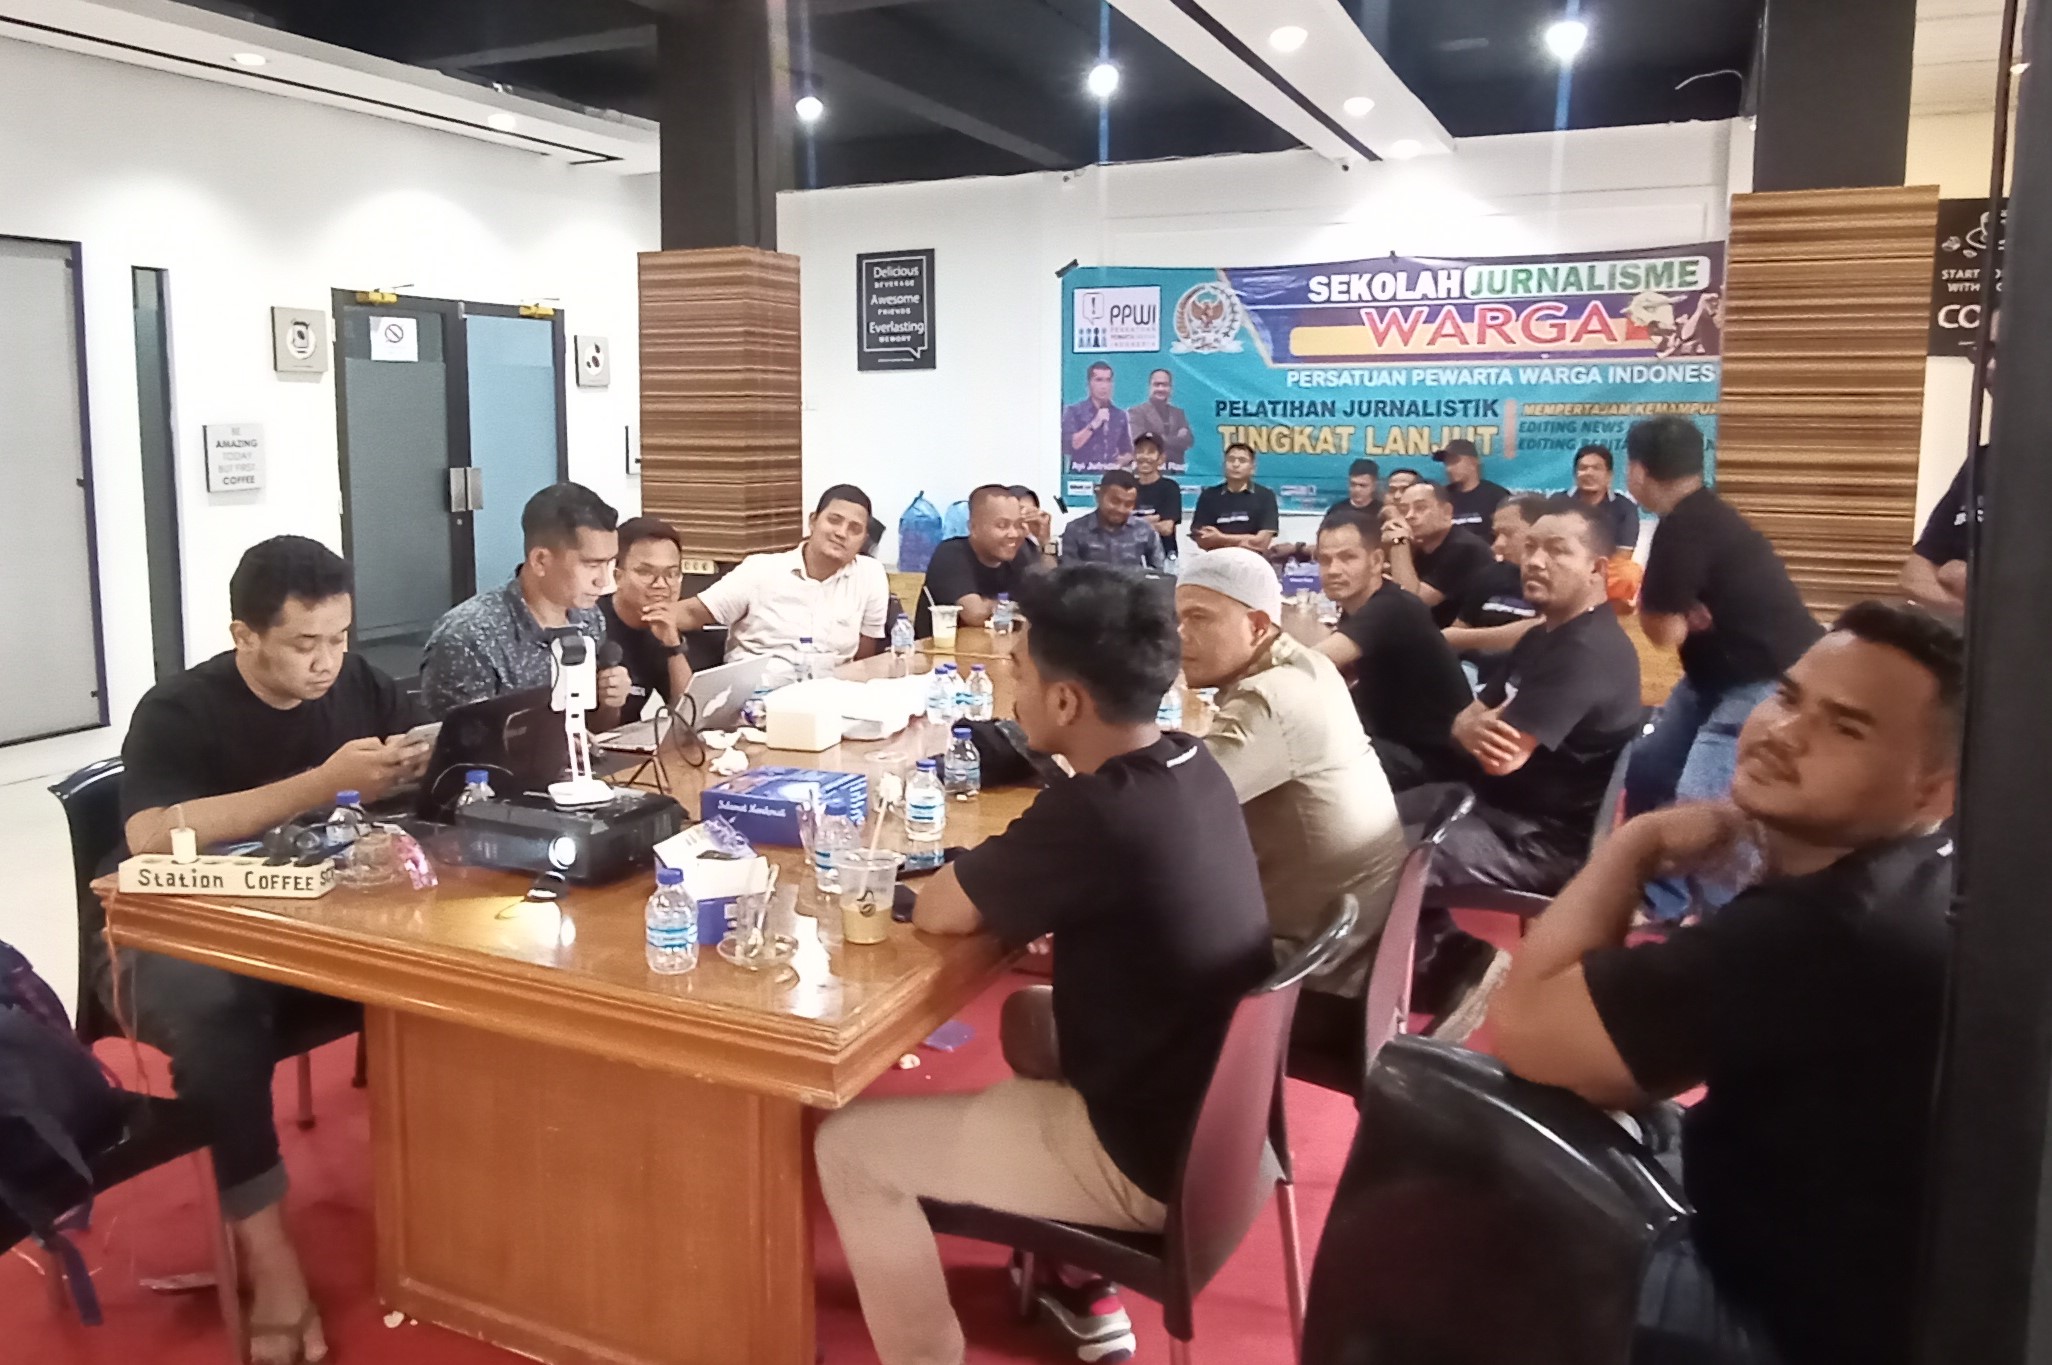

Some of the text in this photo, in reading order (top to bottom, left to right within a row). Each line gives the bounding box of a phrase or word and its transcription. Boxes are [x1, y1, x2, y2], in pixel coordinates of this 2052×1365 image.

[873, 266, 919, 278] Delicious
[1941, 269, 1981, 280] START
[1307, 260, 1700, 303] SEKOLAH JURNALISME
[1947, 283, 1981, 292] WITH
[870, 294, 920, 305] Awesome
[1110, 304, 1156, 325] PPWI
[868, 321, 925, 334] Everlasting
[1361, 302, 1619, 348] WARGA
[1287, 363, 1717, 388] PERSATUAN PEWARTA WARGA INDONES
[1215, 398, 1500, 418] PELATIHAN JURNALISTIK
[1523, 402, 1716, 416] MEMPERTAJAM KEMAMPU
[1518, 420, 1625, 434] EDITING NEWS
[216, 439, 258, 448] AMAZING
[1217, 425, 1356, 455] TINGKAT
[1517, 437, 1576, 451] EDITING
[137, 867, 225, 889] Station
[244, 871, 315, 891] COFFEE
